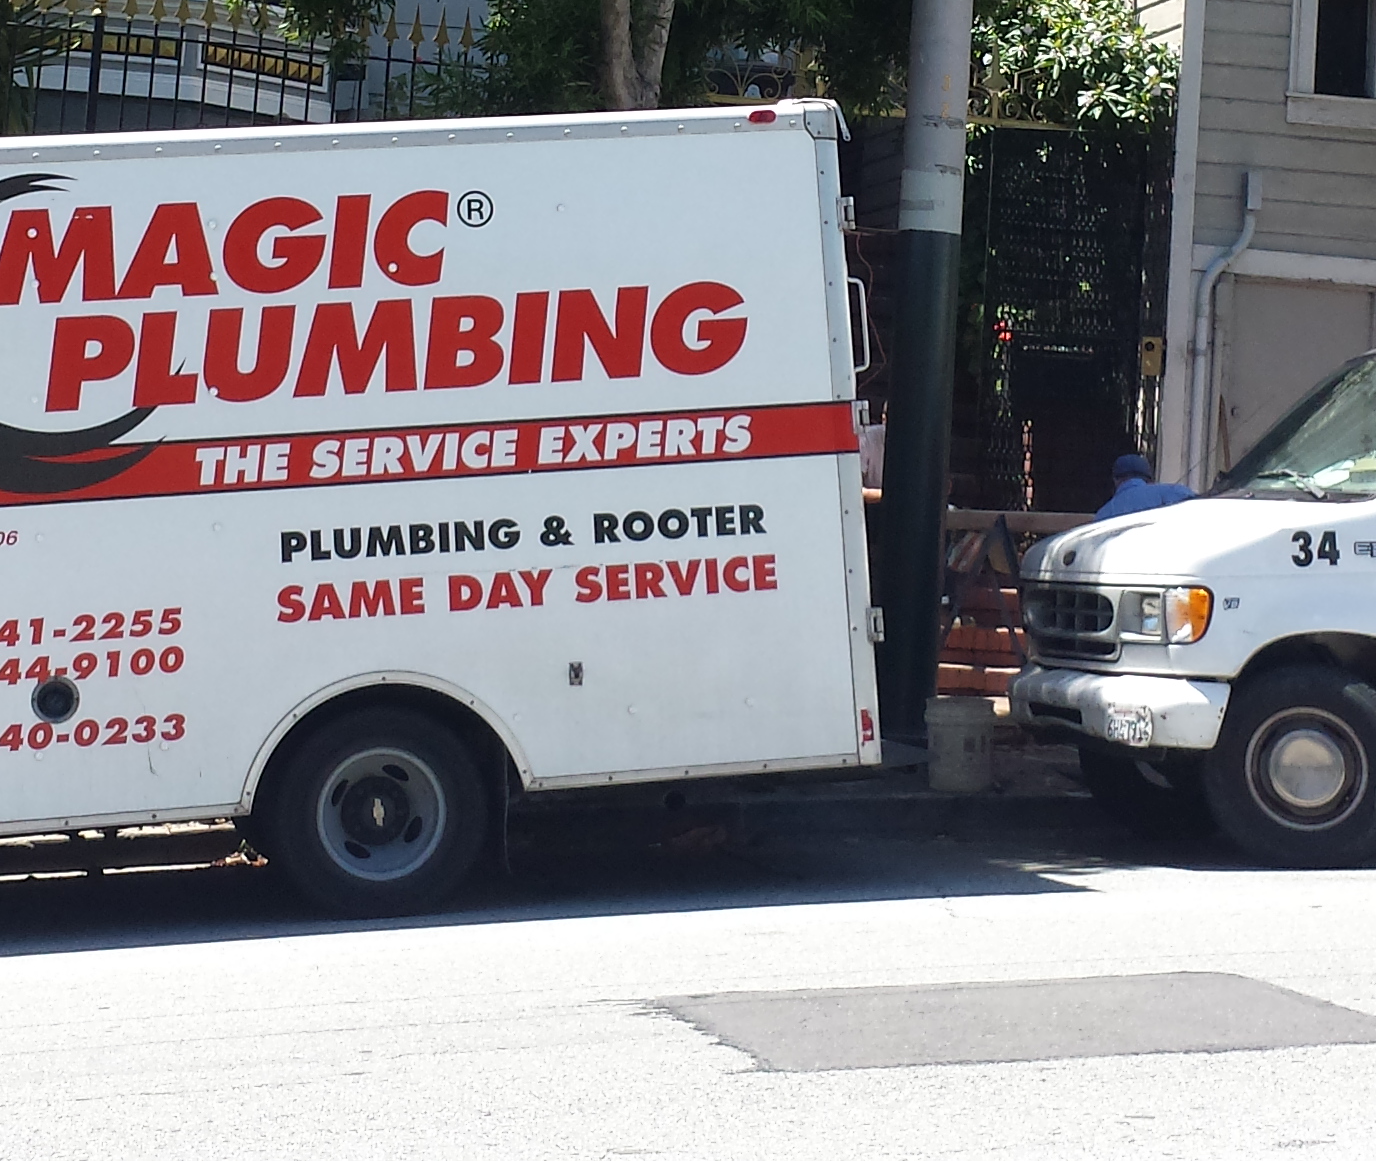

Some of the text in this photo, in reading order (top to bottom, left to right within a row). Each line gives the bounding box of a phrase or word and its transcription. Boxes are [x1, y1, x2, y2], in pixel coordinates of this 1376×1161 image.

[44, 280, 750, 414] PLUMBING
[195, 414, 753, 486] THE SERVICE EXPERTS
[280, 504, 767, 564] PLUMBING & ROOTER
[1291, 530, 1341, 568] 34
[277, 554, 778, 623] SAME DAY SERVICE
